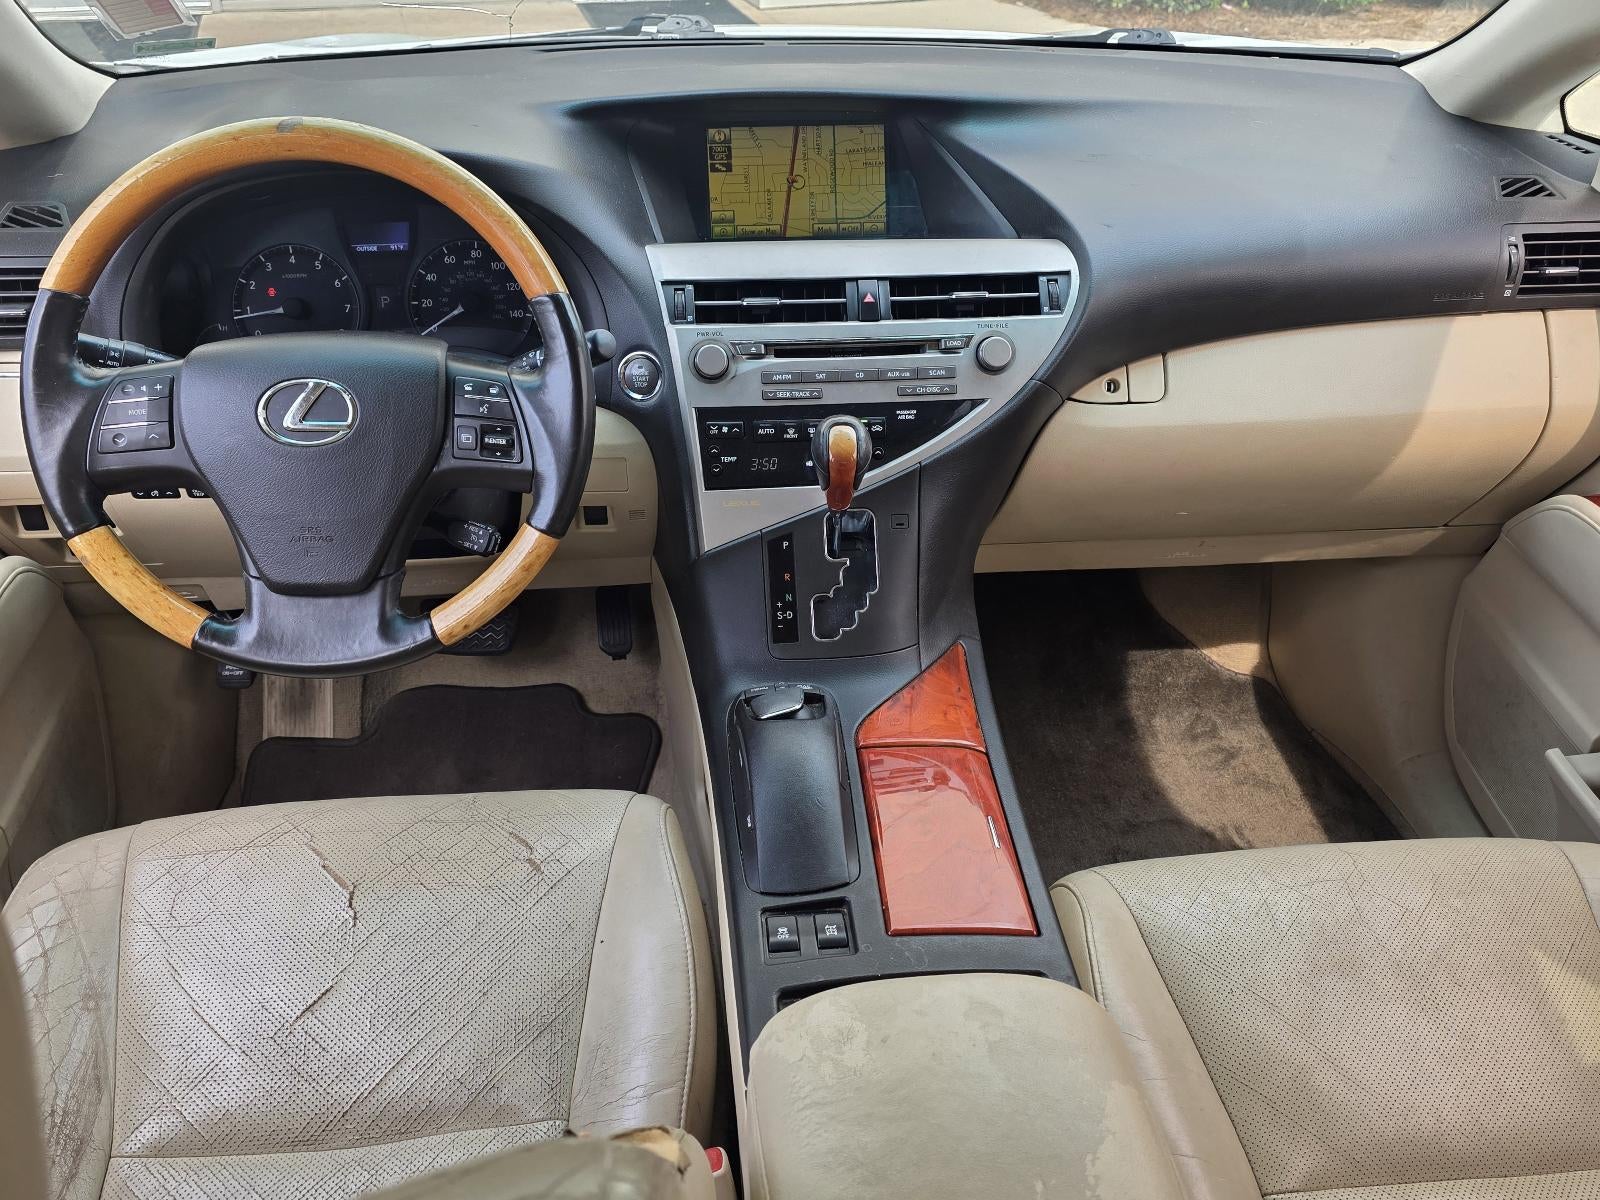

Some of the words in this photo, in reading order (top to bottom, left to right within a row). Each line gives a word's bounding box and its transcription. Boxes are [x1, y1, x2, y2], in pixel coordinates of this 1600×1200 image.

[470, 250, 482, 258] 80
[289, 255, 296, 264] 4
[444, 255, 456, 264] 60
[265, 262, 273, 272] 3
[314, 261, 321, 270] 5
[490, 262, 506, 270] 100
[425, 273, 437, 281] 40
[249, 280, 256, 290] 2
[334, 279, 341, 288] 6
[506, 282, 520, 290] 120
[381, 296, 390, 308] P
[421, 299, 433, 307] 20
[246, 305, 251, 315] 1
[344, 304, 351, 313] 7
[509, 310, 524, 318] 140
[128, 408, 147, 416] MODE
[750, 457, 778, 471] 3:50
[783, 541, 789, 550] P
[784, 573, 791, 581] R
[786, 593, 792, 601] N
